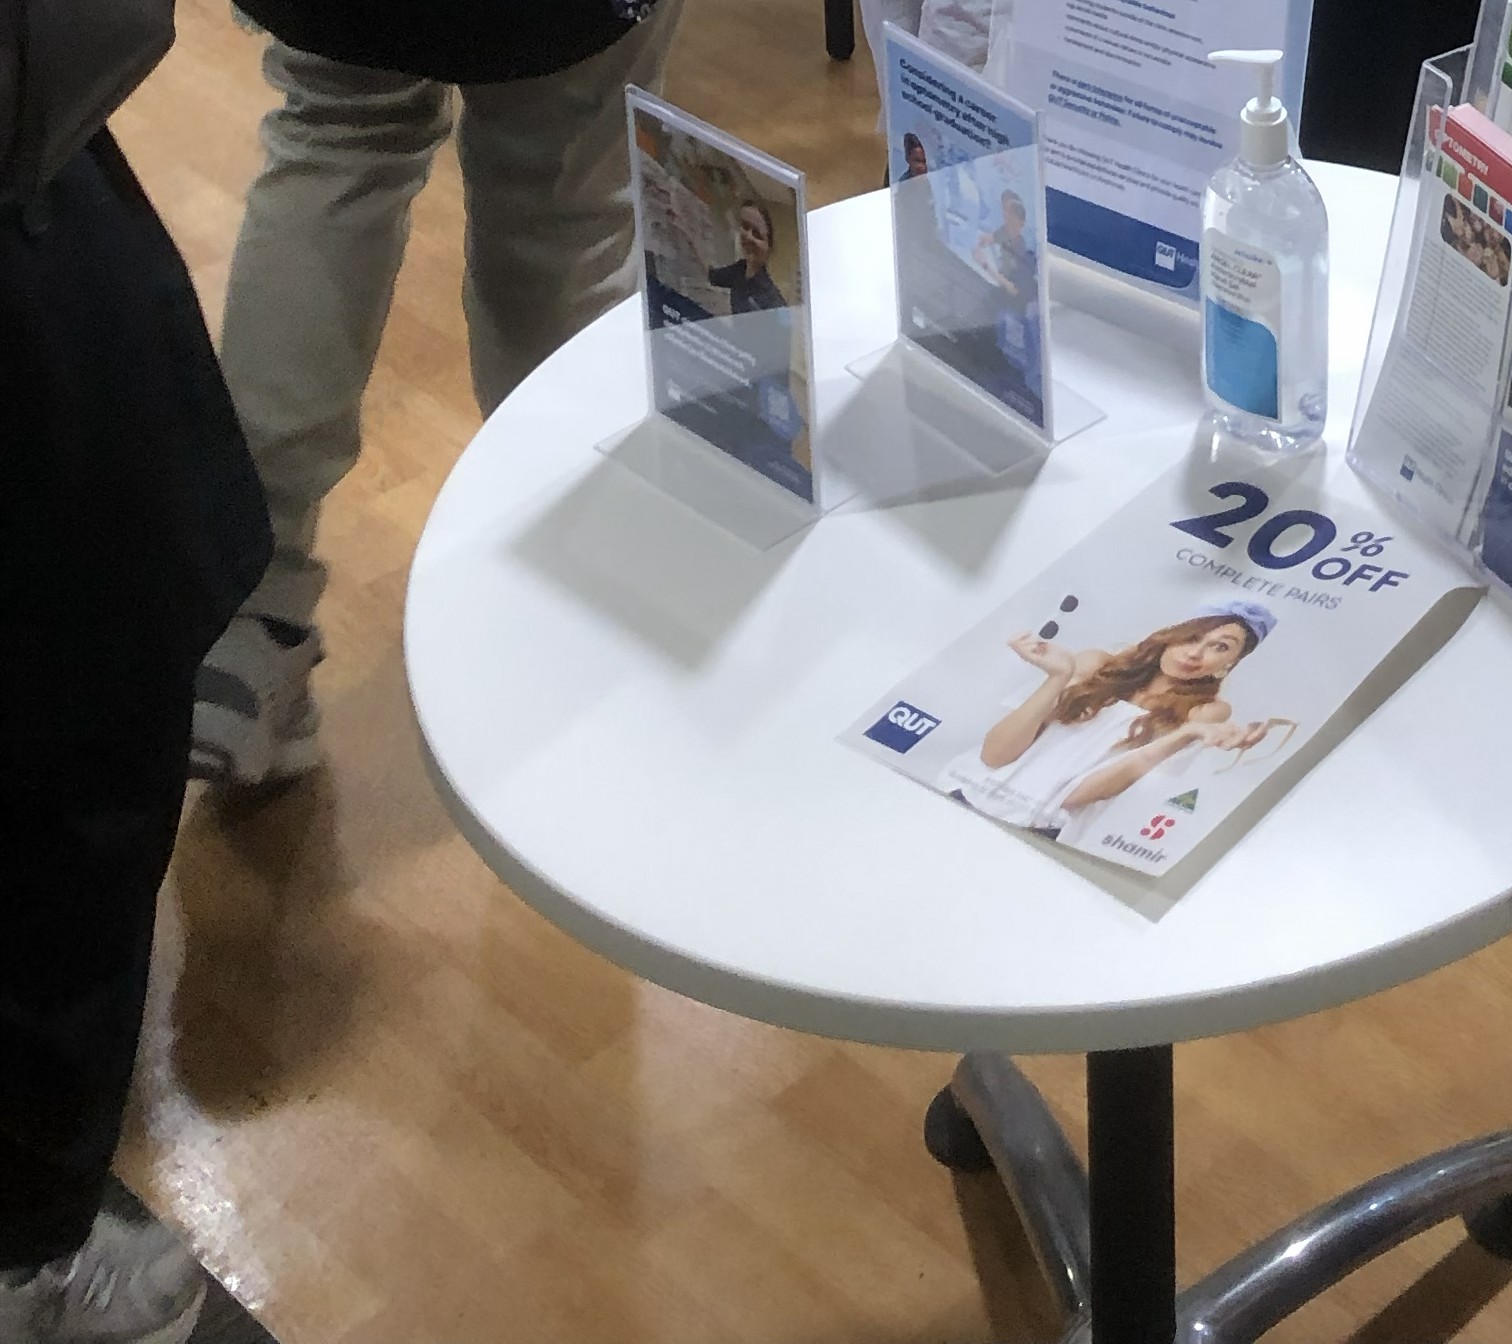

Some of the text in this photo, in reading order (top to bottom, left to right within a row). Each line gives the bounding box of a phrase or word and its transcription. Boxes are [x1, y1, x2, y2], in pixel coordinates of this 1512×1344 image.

[1176, 548, 1343, 610] COMPLETE PAIRS
[1312, 557, 1410, 592] OFF
[888, 706, 936, 736] QUT
[1101, 833, 1168, 863] shamir
